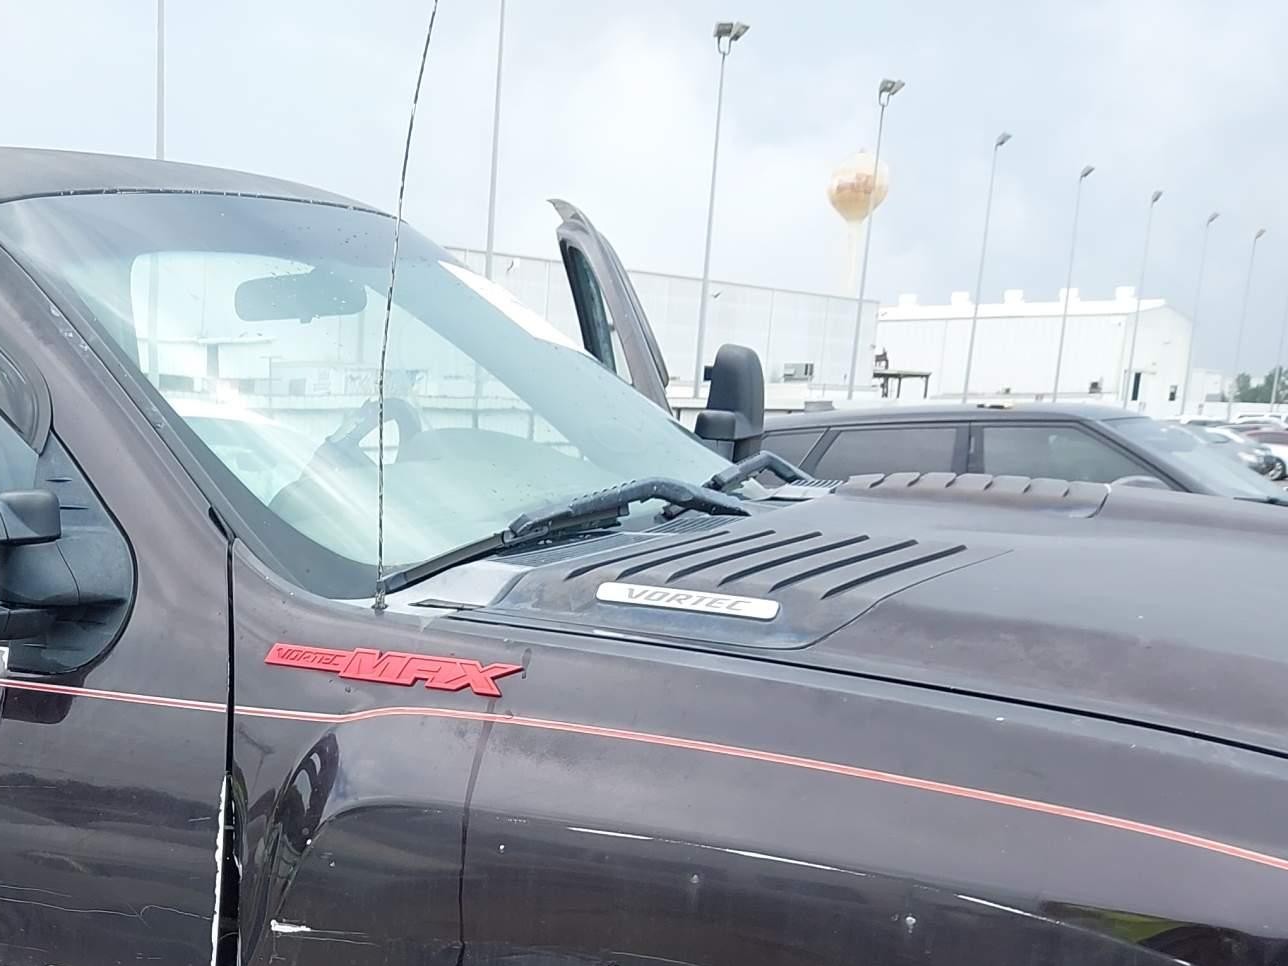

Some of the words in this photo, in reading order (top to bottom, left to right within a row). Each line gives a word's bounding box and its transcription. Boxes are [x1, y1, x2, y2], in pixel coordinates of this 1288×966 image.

[626, 587, 754, 612] VORTEC
[276, 646, 348, 668] VORTEC
[339, 647, 524, 698] MAX
